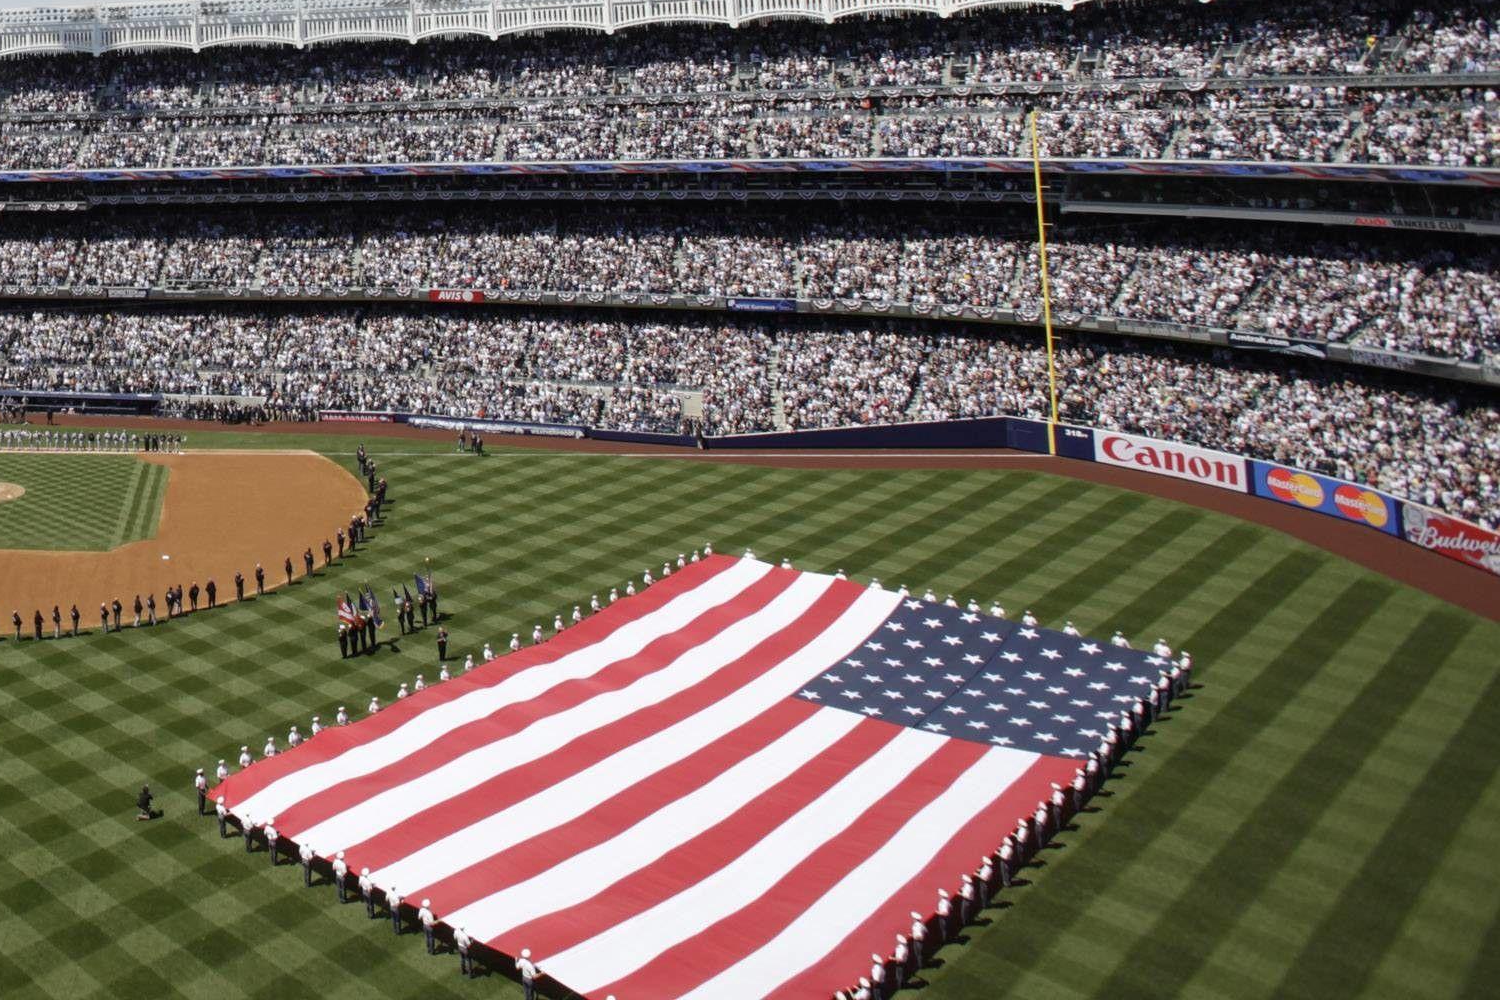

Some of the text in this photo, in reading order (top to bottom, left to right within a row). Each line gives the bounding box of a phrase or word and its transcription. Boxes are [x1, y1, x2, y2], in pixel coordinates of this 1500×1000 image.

[438, 291, 462, 301] AVIS
[1102, 436, 1238, 486] Canon
[1266, 475, 1322, 499] MasterCard
